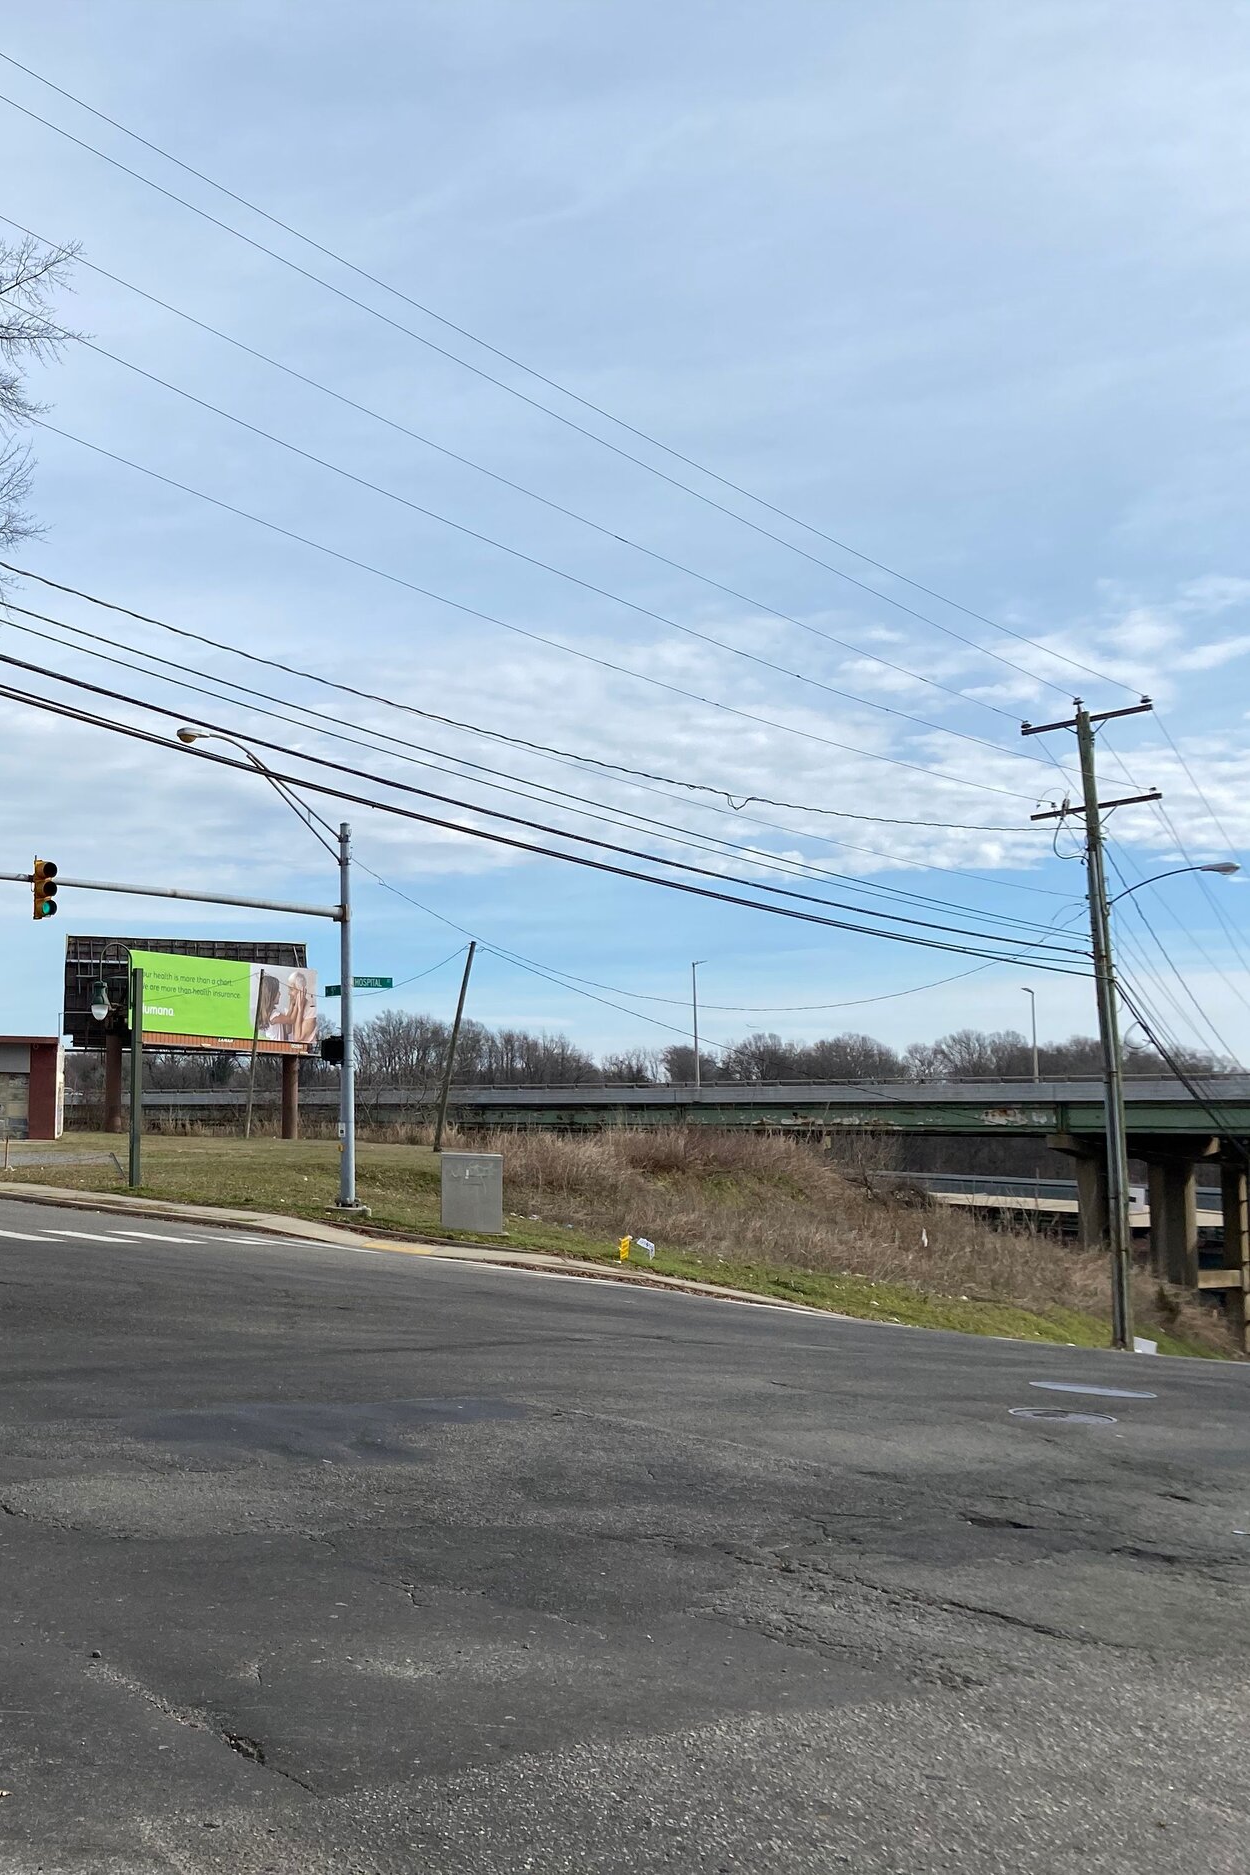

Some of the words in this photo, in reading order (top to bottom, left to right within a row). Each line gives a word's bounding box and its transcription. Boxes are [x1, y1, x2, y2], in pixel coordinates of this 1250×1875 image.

[154, 971, 173, 980] health
[180, 975, 195, 983] more
[197, 976, 210, 984] than
[354, 978, 382, 987] HOSPITAL
[161, 985, 176, 993] more
[178, 986, 191, 995] than
[193, 988, 211, 996] health
